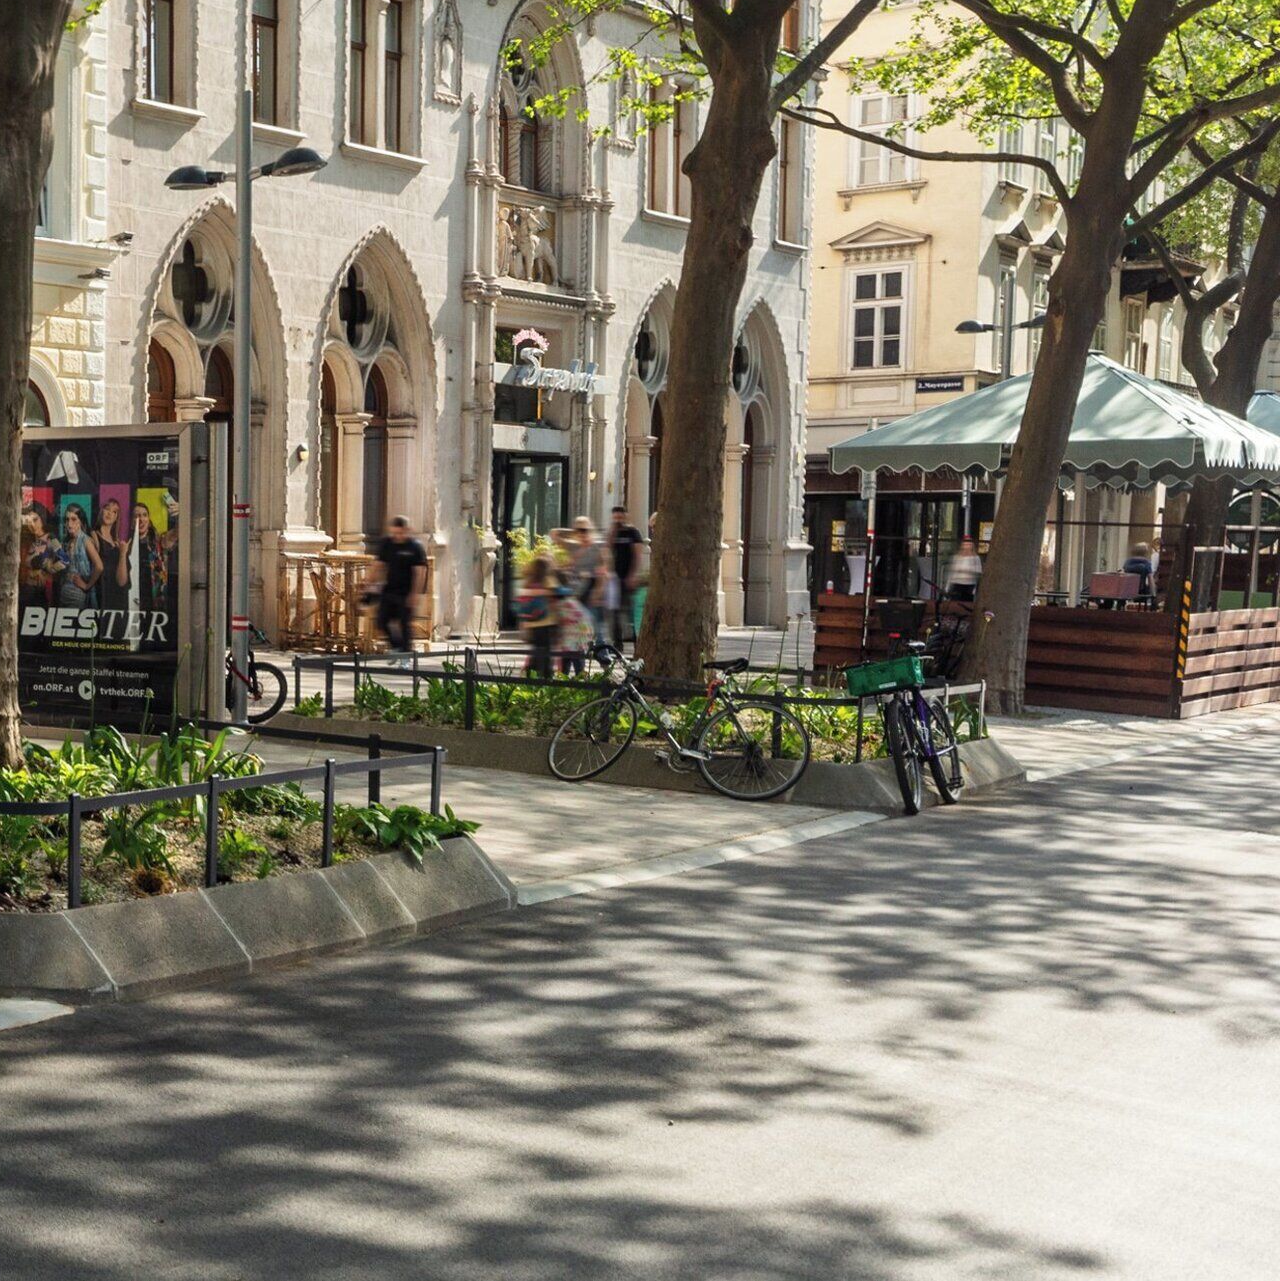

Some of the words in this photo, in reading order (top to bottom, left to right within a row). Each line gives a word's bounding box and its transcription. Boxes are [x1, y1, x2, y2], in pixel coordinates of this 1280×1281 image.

[148, 454, 167, 462] ORF
[20, 606, 169, 642] BIESTER
[57, 665, 68, 674] die
[115, 671, 149, 679] streamen
[33, 683, 74, 693] on.ORF.at
[100, 687, 155, 699] tvthek.ORF.t
